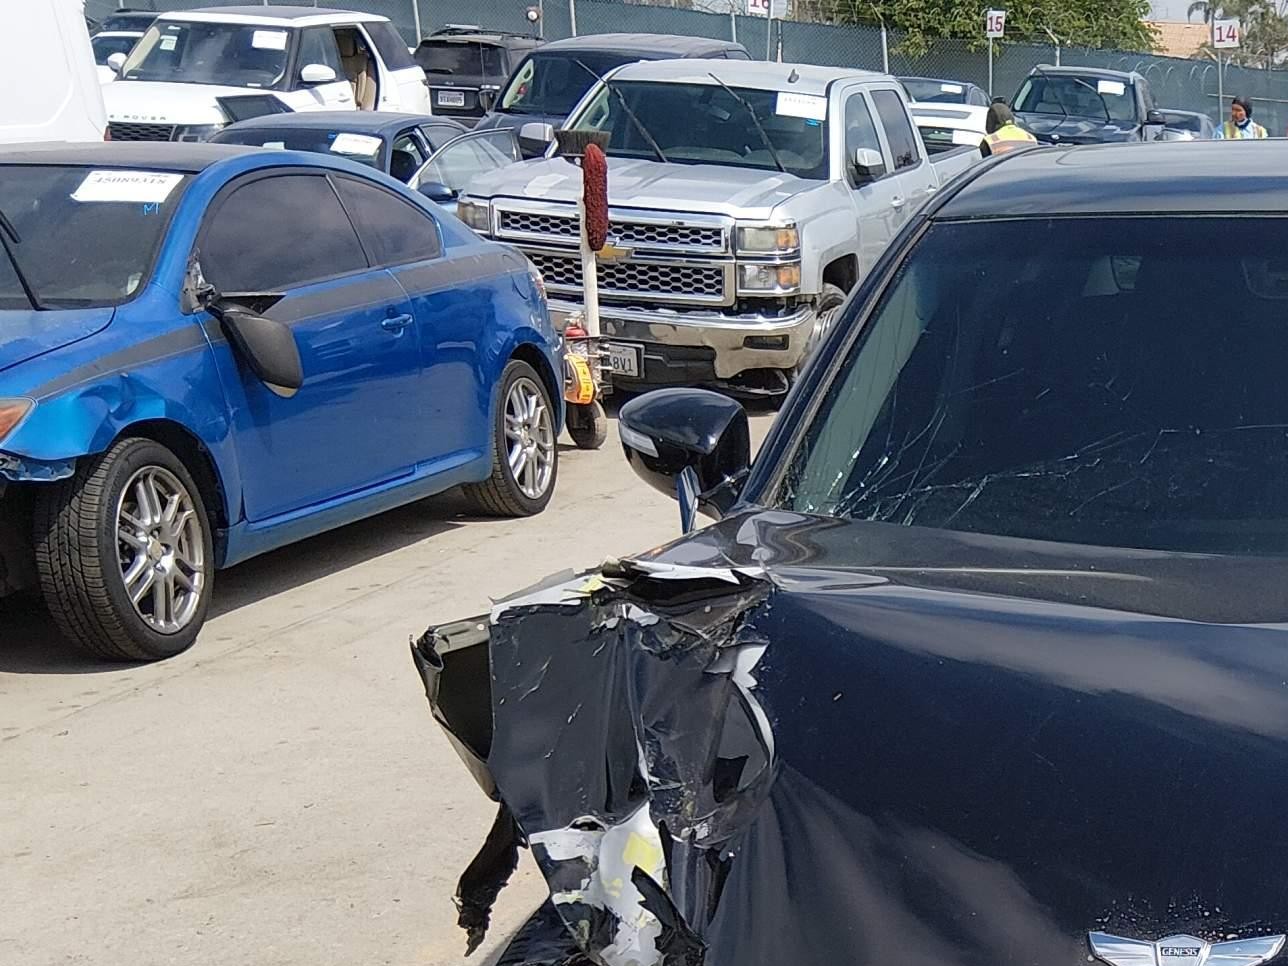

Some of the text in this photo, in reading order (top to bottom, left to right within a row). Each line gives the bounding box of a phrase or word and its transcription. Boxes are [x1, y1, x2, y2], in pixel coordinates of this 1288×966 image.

[987, 15, 1004, 32] 15
[1215, 24, 1237, 43] 14
[1161, 947, 1199, 957] GENESIS
